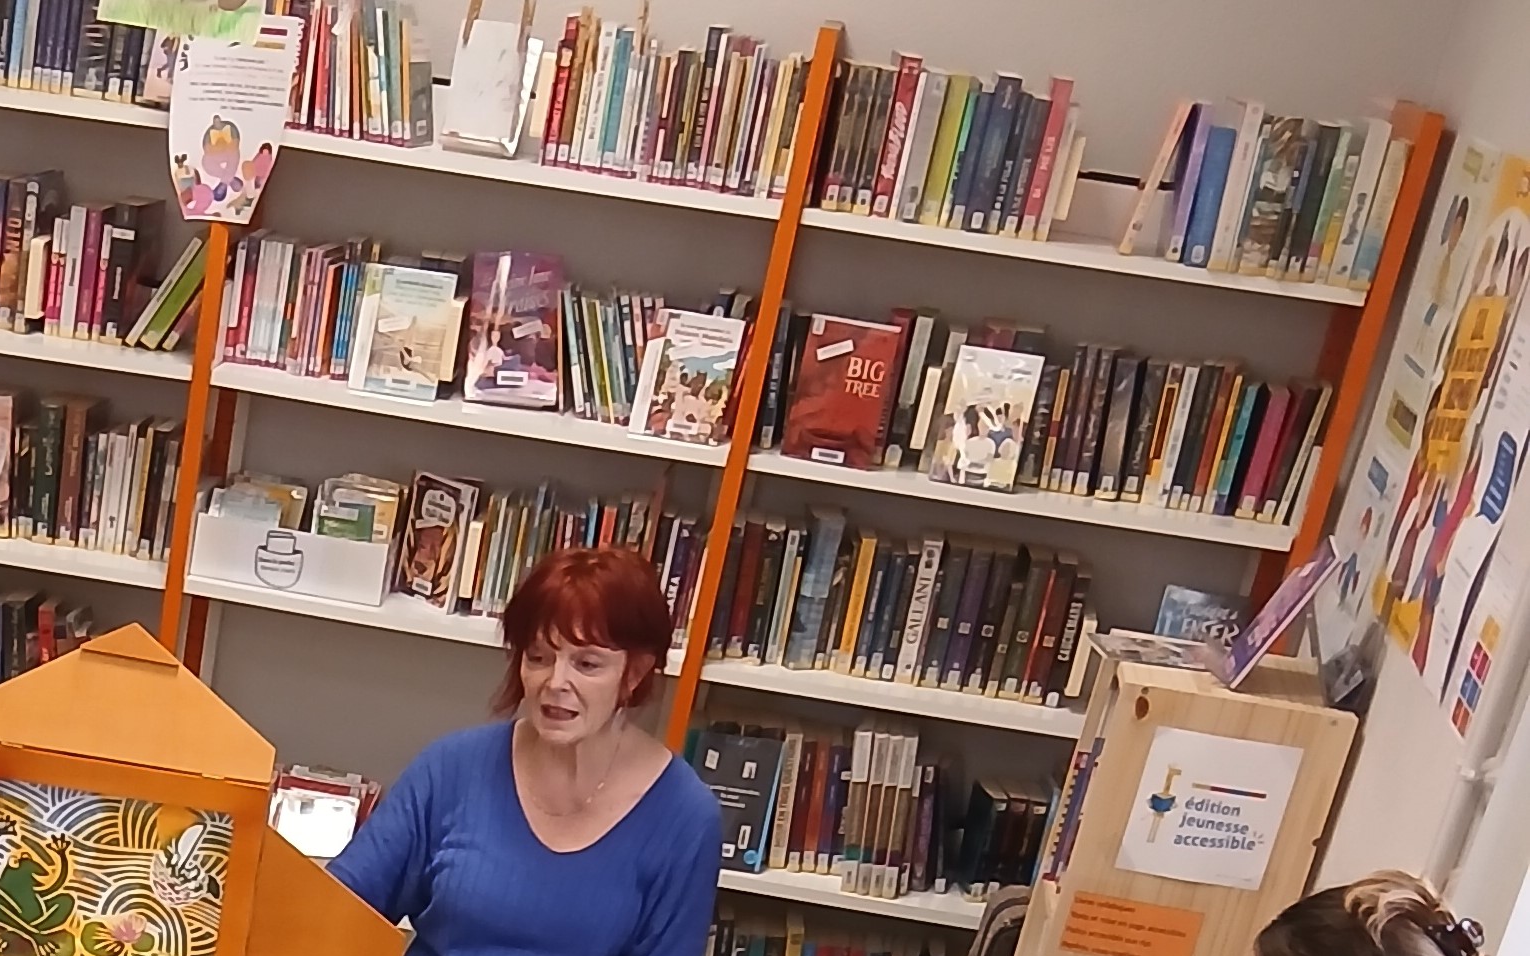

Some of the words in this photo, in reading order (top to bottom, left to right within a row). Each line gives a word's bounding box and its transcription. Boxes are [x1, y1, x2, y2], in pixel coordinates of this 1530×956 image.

[846, 356, 886, 382] BIG
[843, 378, 882, 398] TREE
[1184, 796, 1241, 817] édition
[1178, 812, 1250, 835] jeunesse
[1173, 832, 1256, 851] accessible
